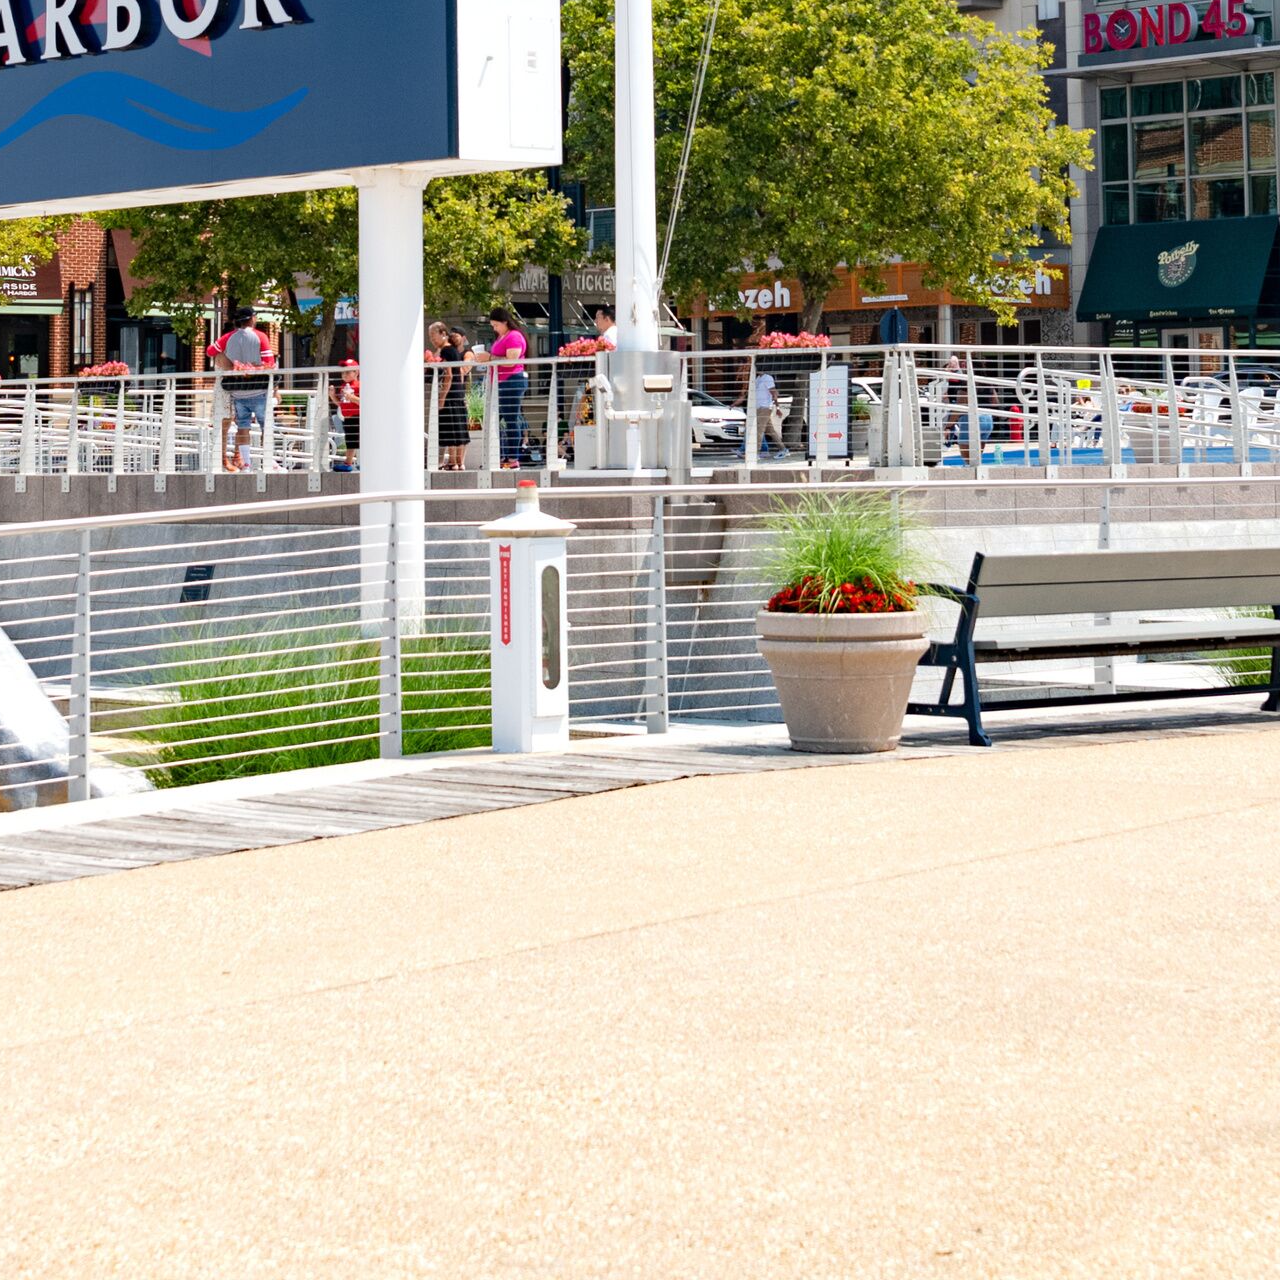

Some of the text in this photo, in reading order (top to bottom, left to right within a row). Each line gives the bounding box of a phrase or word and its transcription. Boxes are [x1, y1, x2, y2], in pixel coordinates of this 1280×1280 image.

[1084, 3, 1190, 54] BOND
[1157, 240, 1200, 265] Potbelly
[520, 272, 571, 291] MARA
[968, 267, 1051, 295] eeh
